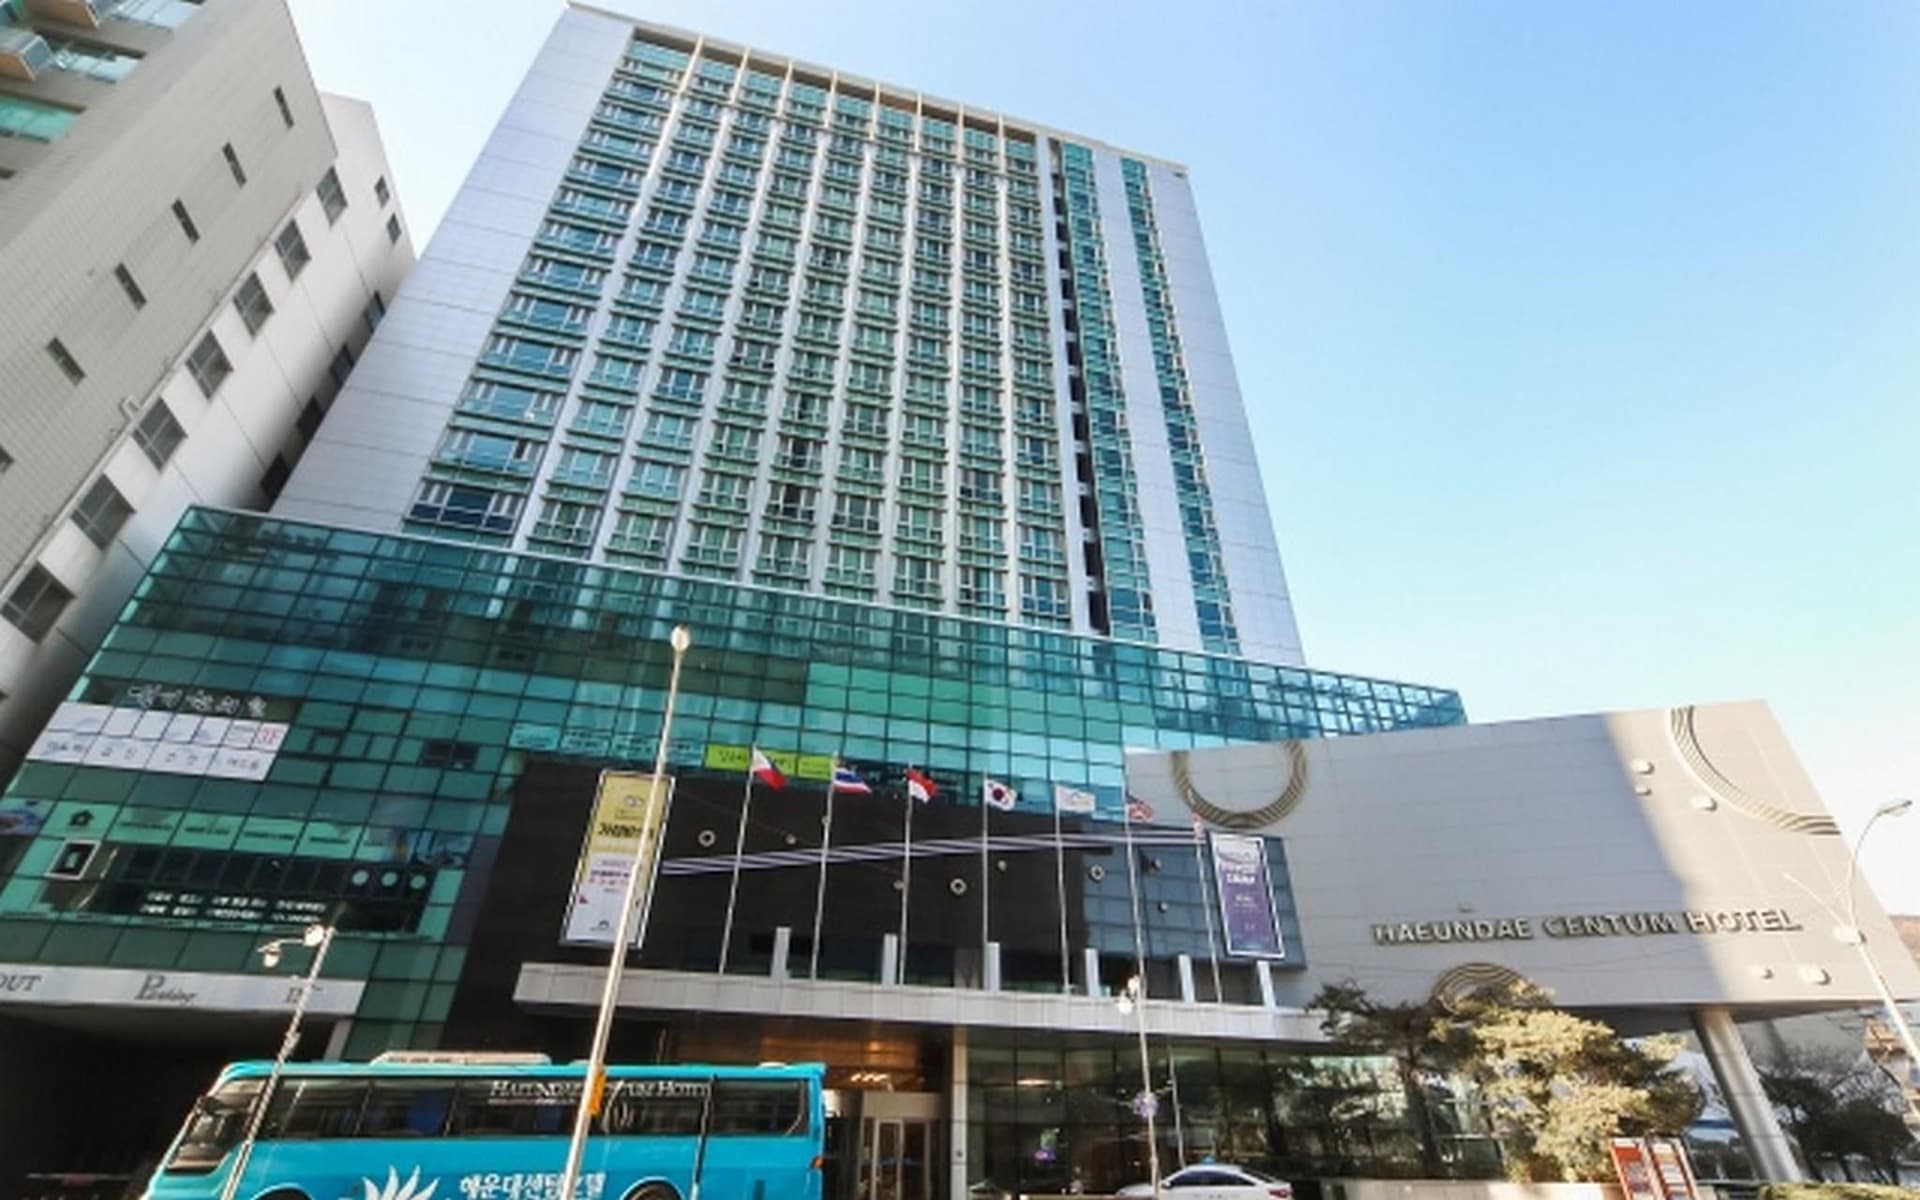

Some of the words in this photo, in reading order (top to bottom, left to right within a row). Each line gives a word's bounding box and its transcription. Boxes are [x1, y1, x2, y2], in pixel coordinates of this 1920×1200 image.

[1372, 918, 1534, 945] HAEUNDAE
[1542, 912, 1678, 938] CENTUM
[1684, 907, 1804, 934] HOTEL
